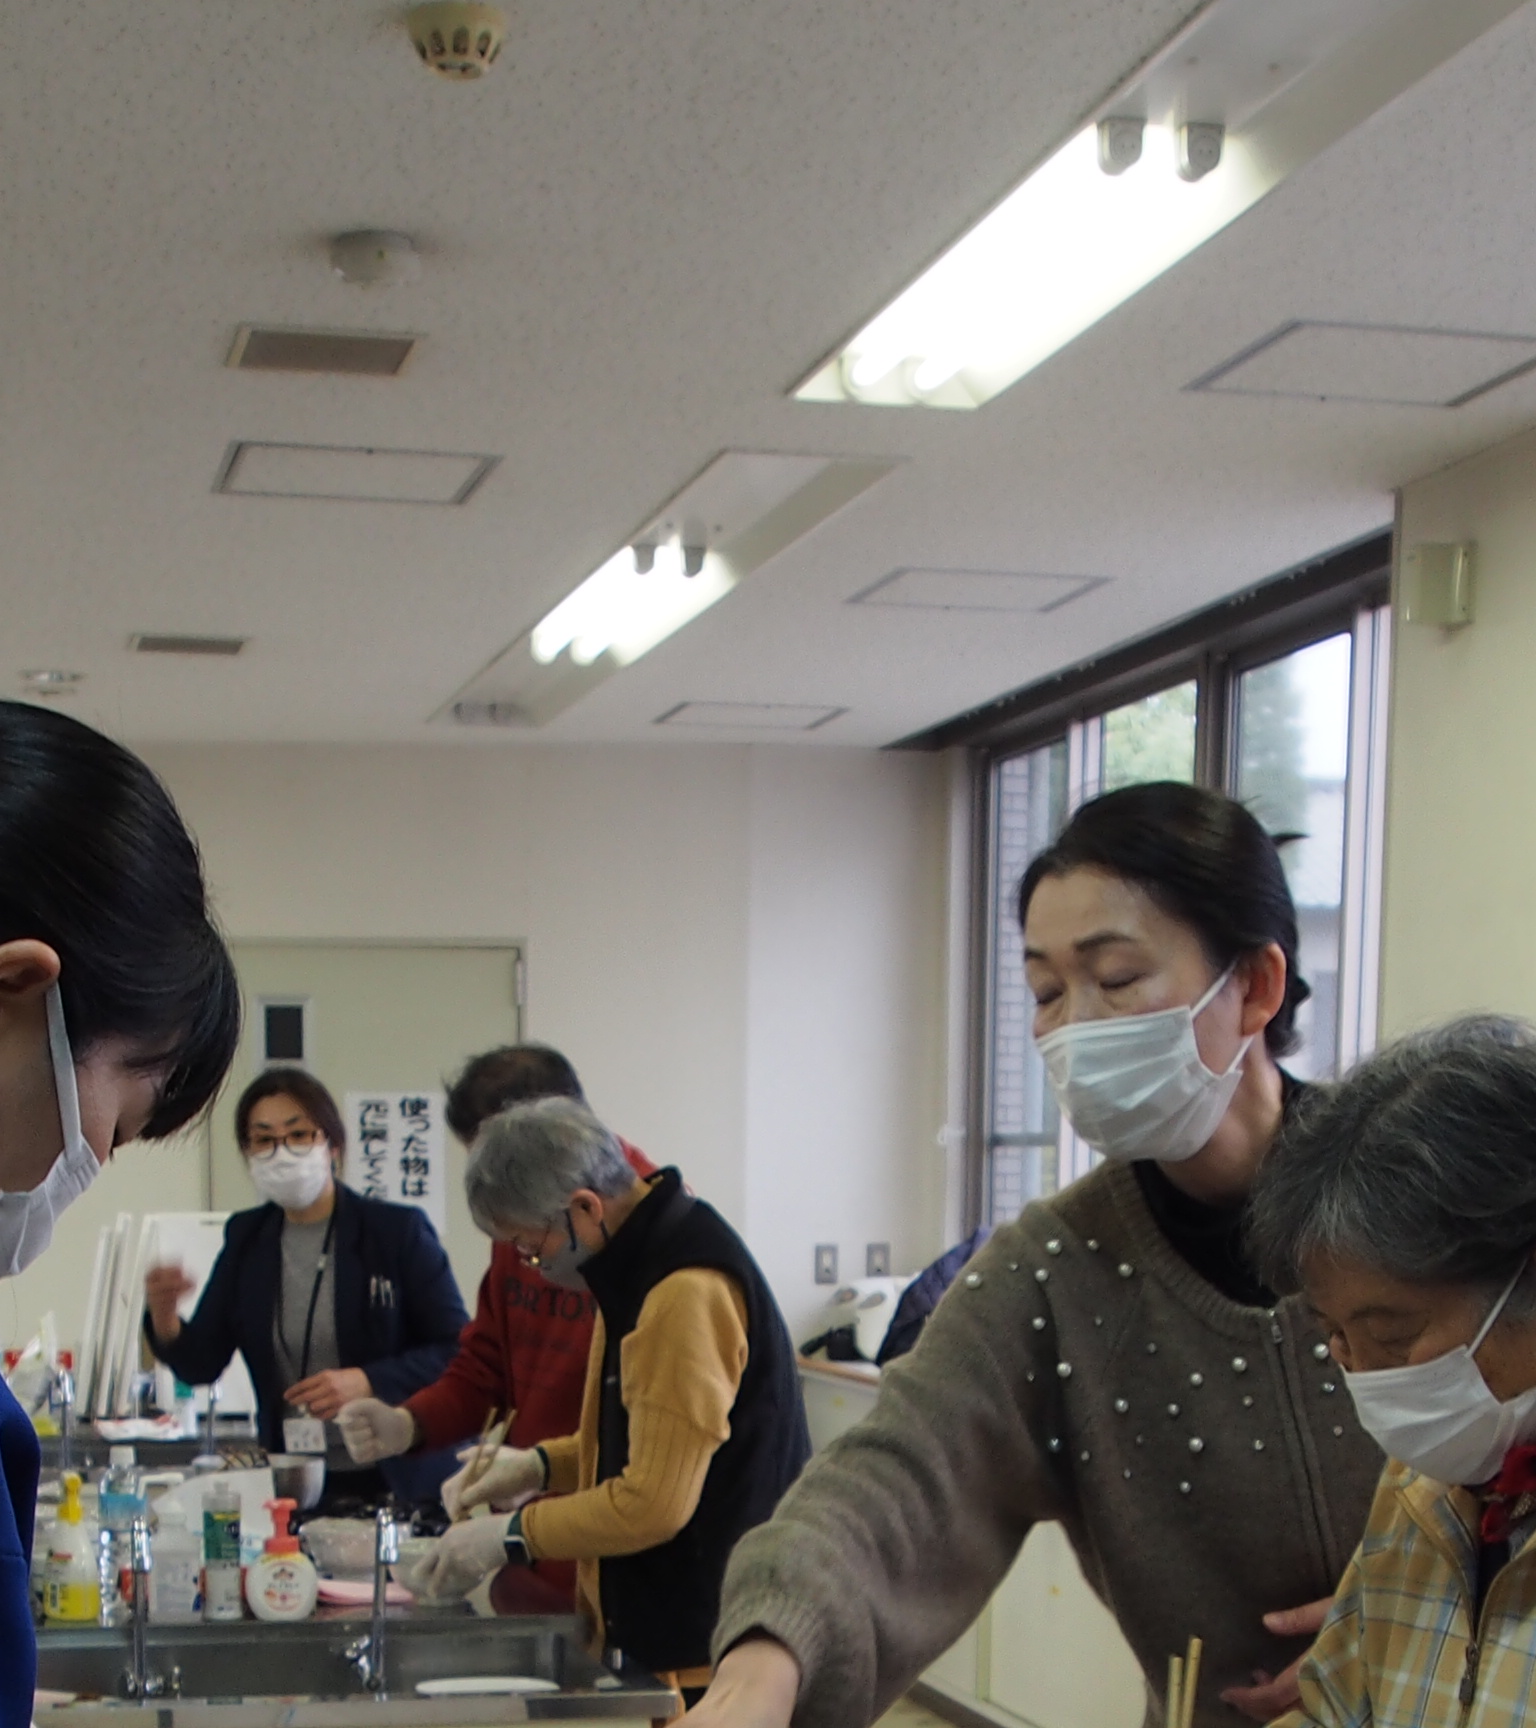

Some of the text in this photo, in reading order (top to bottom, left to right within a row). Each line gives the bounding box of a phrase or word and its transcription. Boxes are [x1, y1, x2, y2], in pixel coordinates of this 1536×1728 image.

[398, 1096, 431, 1196] 使った物は
